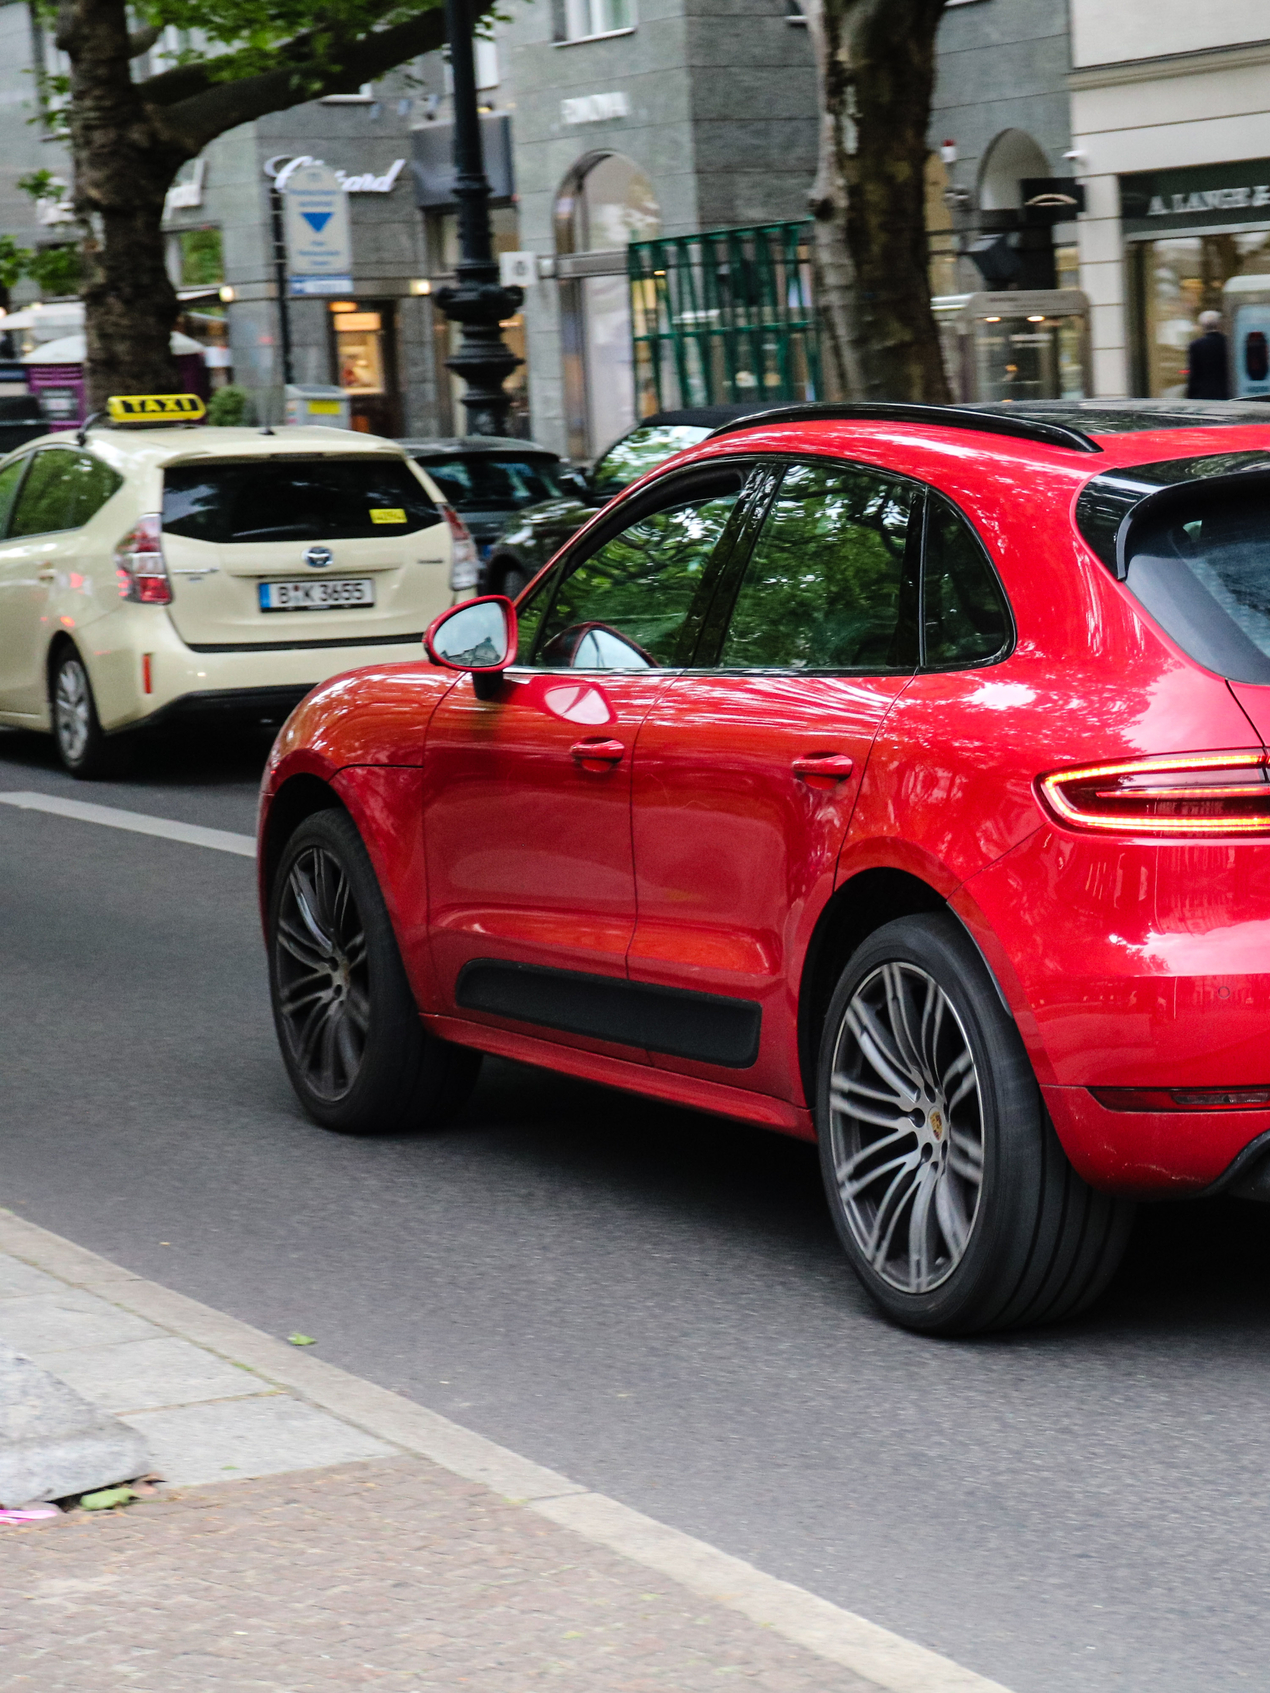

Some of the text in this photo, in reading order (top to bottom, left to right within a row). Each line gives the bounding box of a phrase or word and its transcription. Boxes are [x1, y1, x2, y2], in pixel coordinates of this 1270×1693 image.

[1171, 186, 1251, 213] LANGE
[128, 398, 190, 413] TAXI
[277, 585, 291, 604] B
